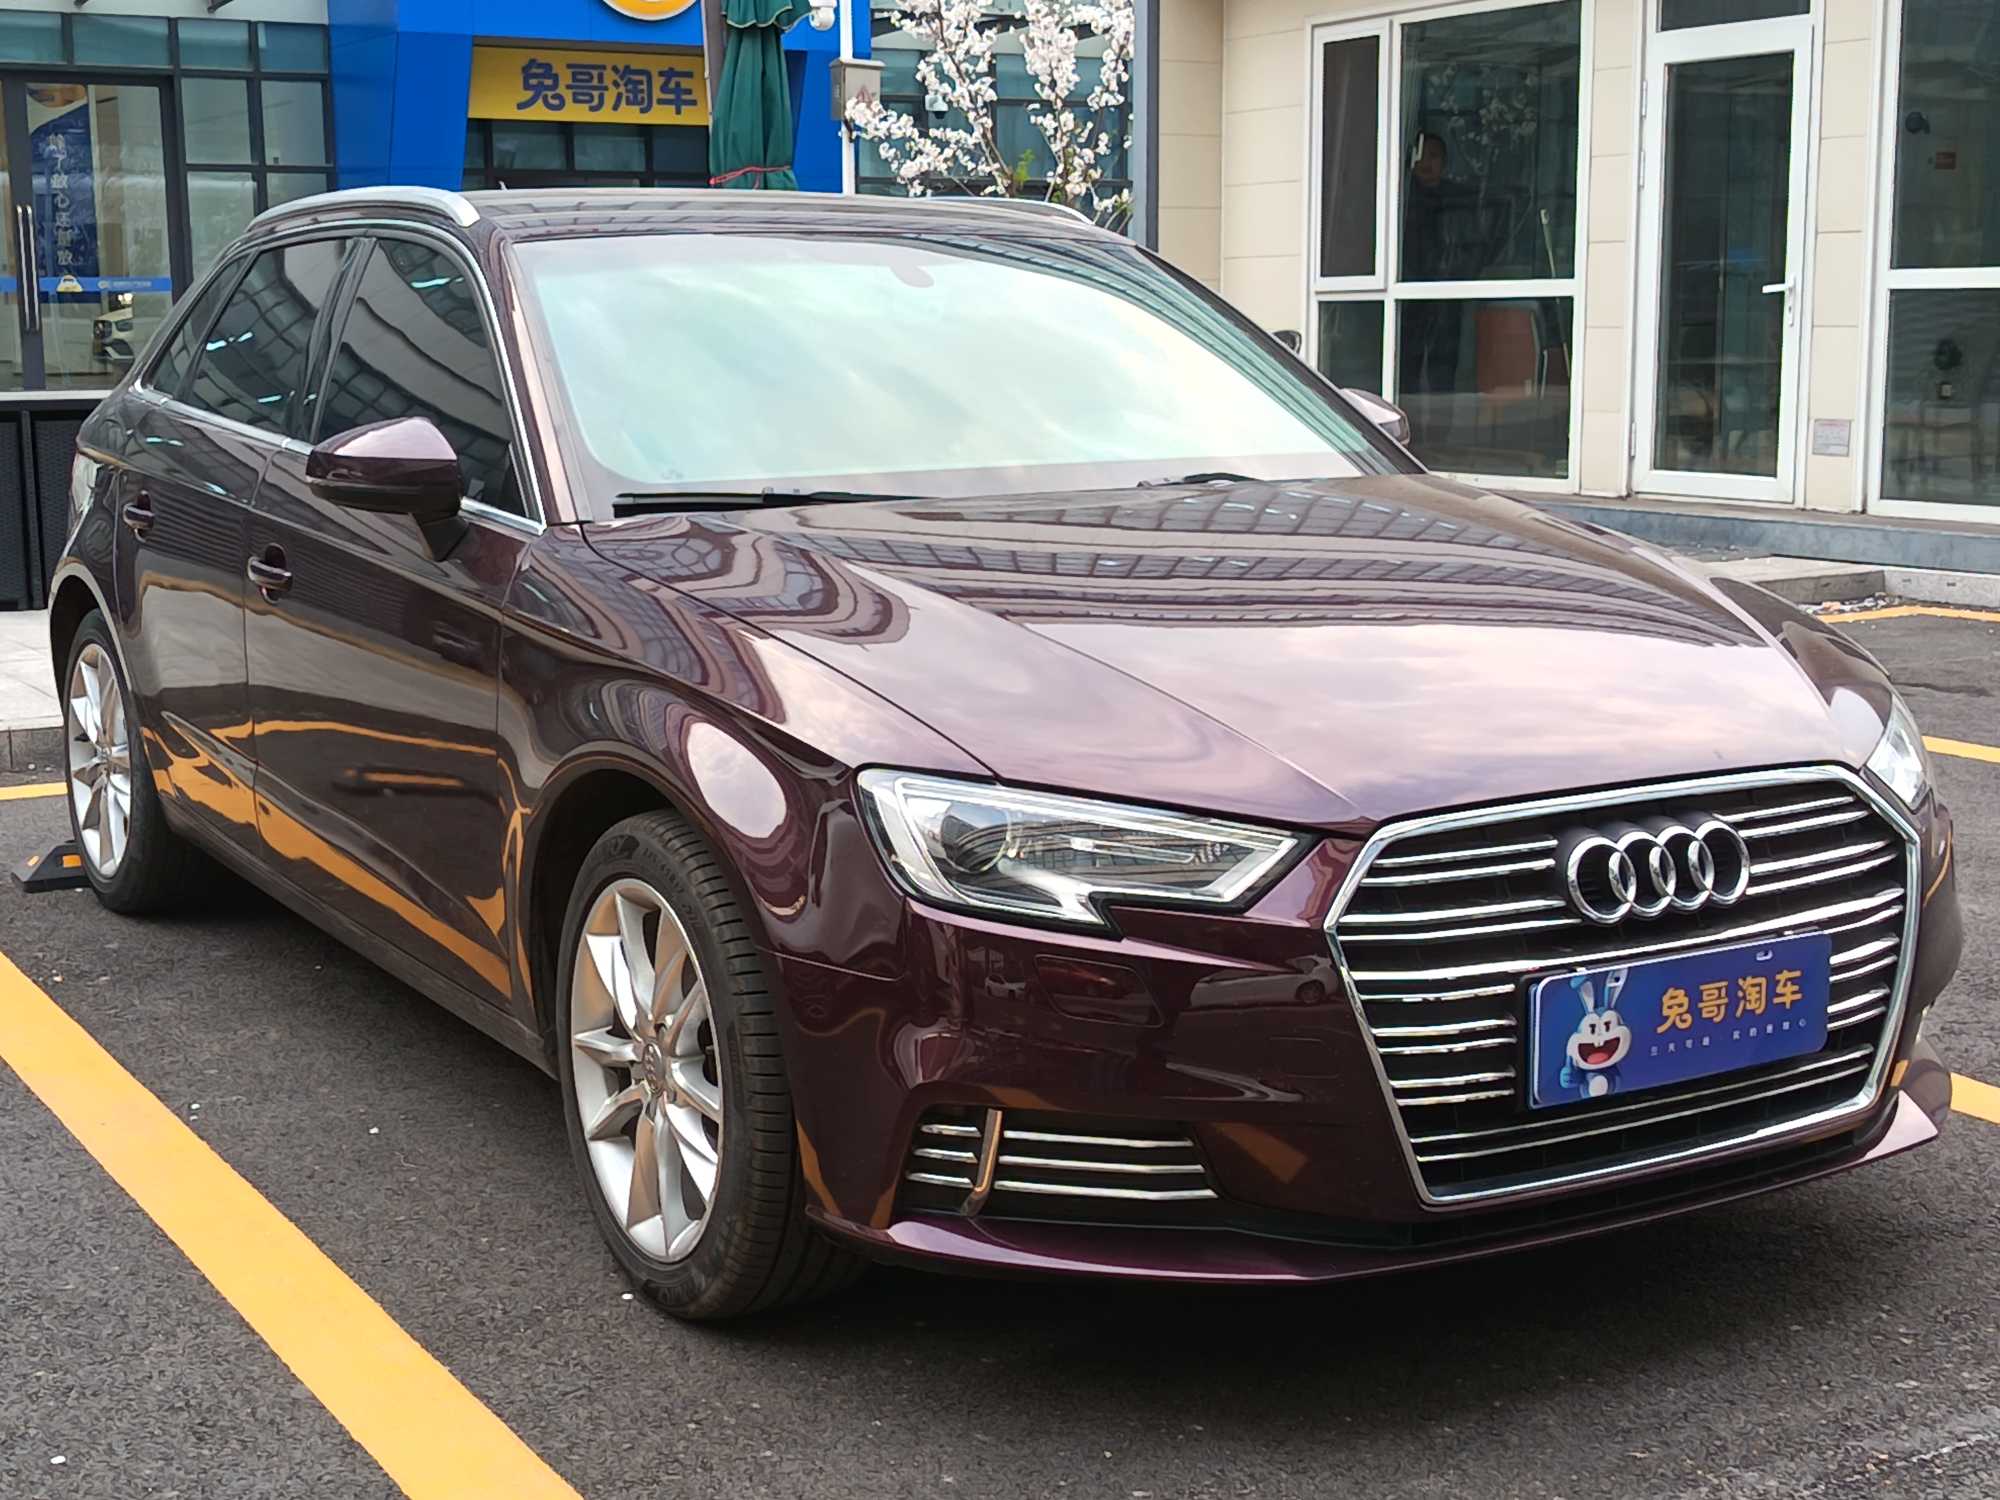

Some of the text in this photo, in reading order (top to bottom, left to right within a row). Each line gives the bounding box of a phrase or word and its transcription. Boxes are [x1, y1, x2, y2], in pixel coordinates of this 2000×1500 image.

[516, 58, 698, 116] 兔哥淘车
[1656, 969, 1803, 1034] 兔哥淘车
